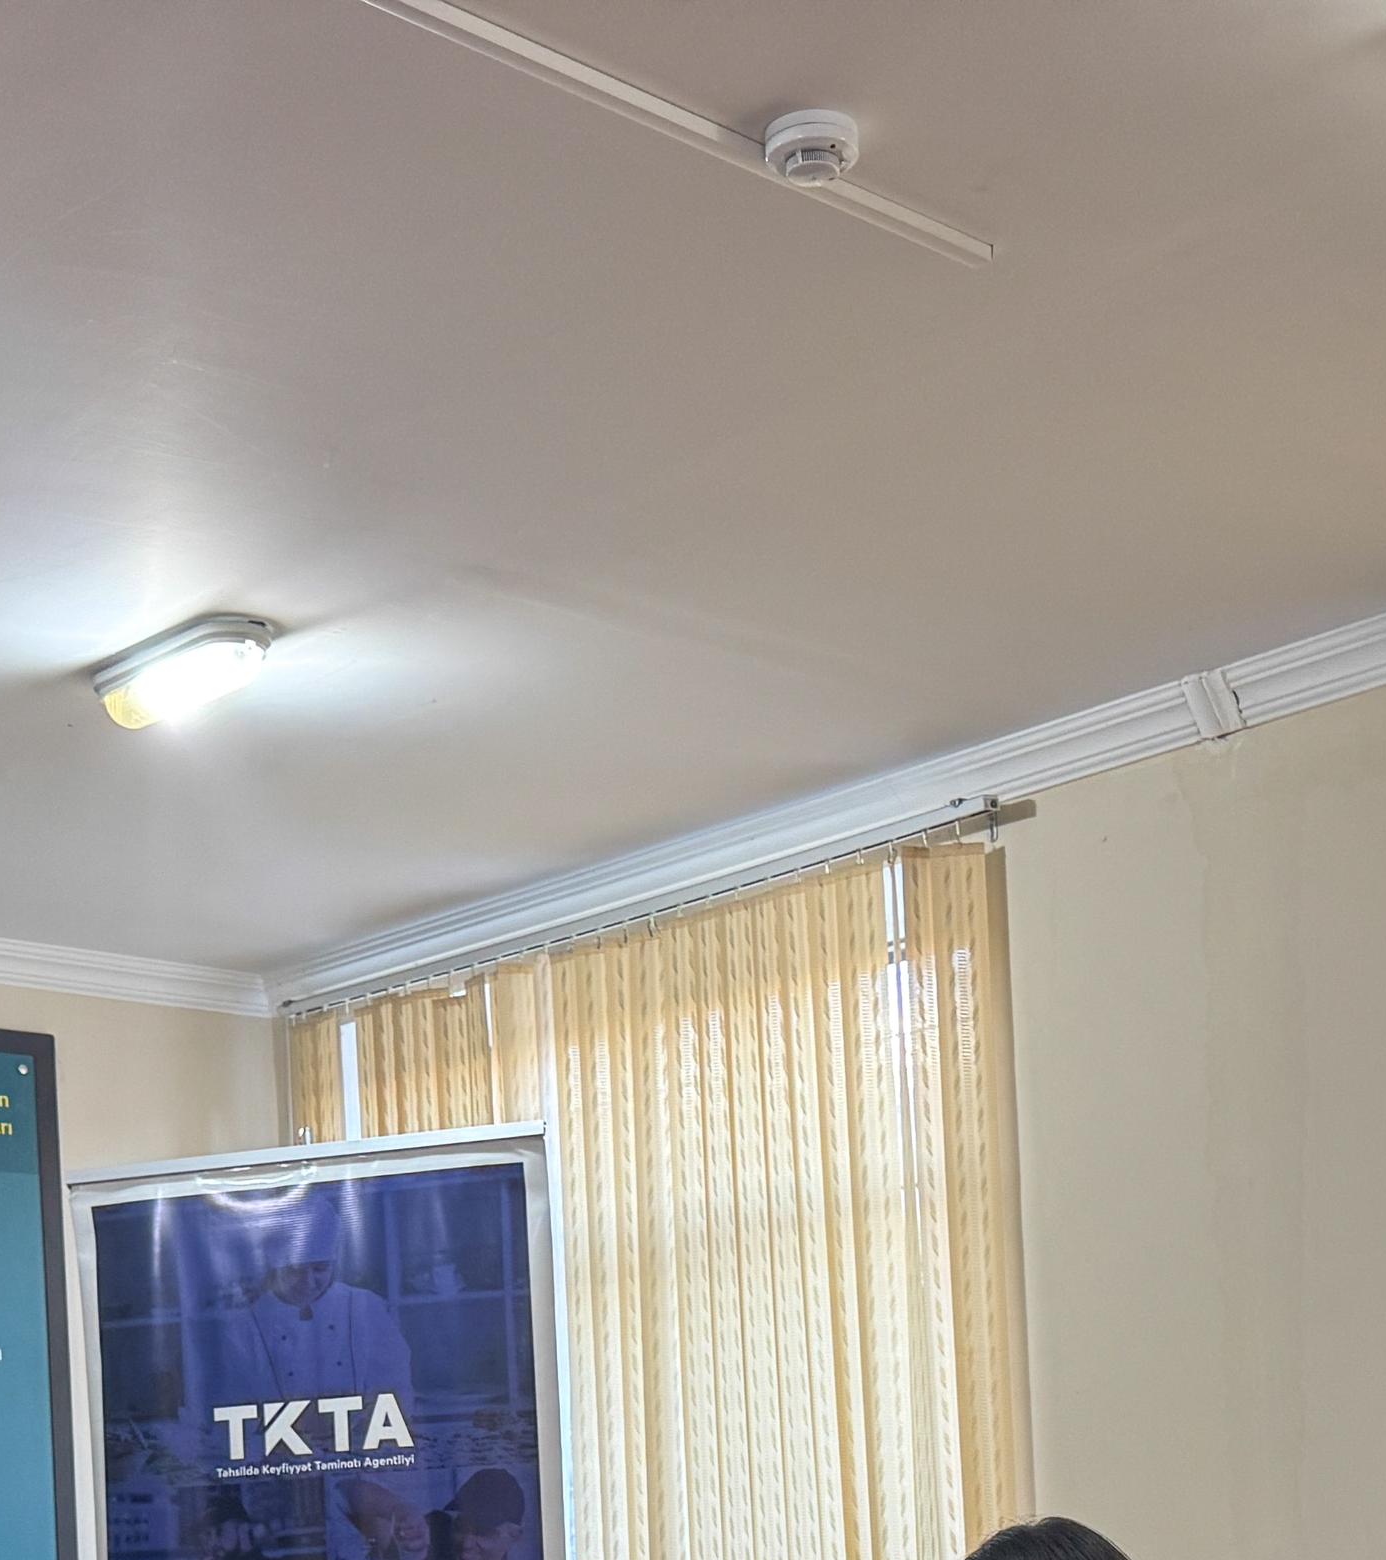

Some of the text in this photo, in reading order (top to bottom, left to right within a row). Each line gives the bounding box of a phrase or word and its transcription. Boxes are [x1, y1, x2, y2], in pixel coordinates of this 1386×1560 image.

[213, 1393, 415, 1460] TKTA
[216, 1454, 415, 1479] Təhsildə Keyfiyyət Təminatı Agentliyi
